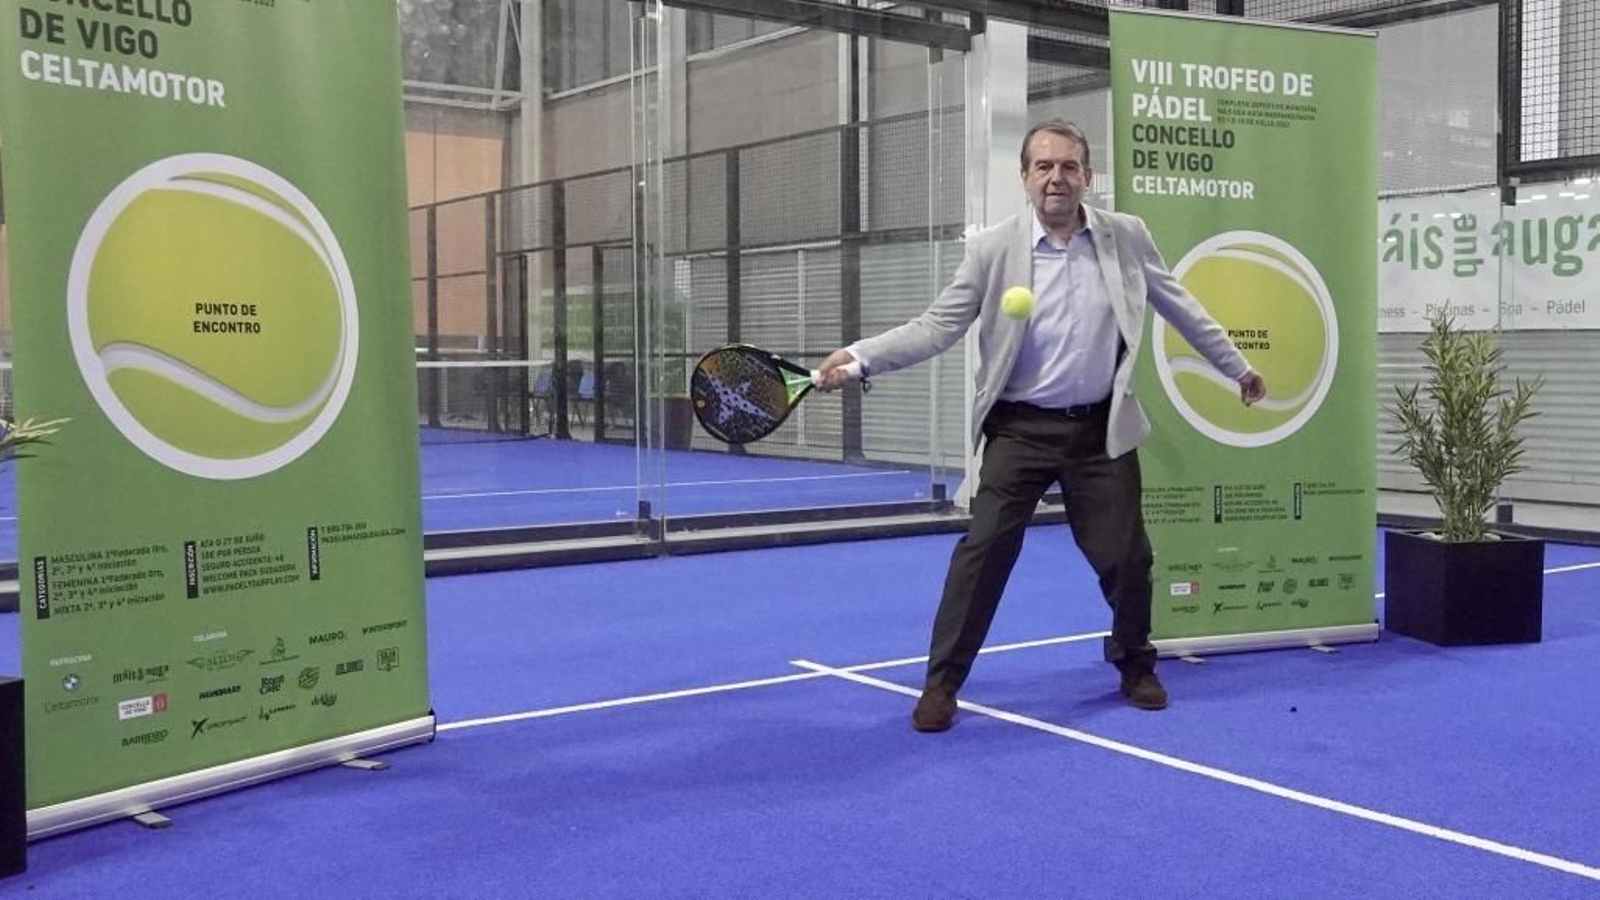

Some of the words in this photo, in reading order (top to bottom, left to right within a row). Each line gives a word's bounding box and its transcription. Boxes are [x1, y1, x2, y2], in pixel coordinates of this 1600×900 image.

[20, 7, 65, 45] DE
[77, 17, 158, 60] VIGO
[20, 49, 226, 107] CELTAMOTOR
[1131, 59, 1173, 86] VIII
[1180, 63, 1275, 95] TROFEO
[1282, 72, 1313, 97] DE
[1132, 87, 1212, 122] PÁDEL
[1132, 123, 1235, 149] CONCELLO
[1132, 149, 1158, 169] DE
[1166, 151, 1213, 173] VIGO
[1132, 175, 1255, 199] CELTAMOTOR
[195, 302, 238, 315] PUNTO
[241, 304, 257, 316] DE
[1546, 300, 1585, 314] Pádel
[193, 320, 261, 333] ENCONTRO
[1228, 329, 1256, 338] PUNTO
[1257, 329, 1269, 338] DE
